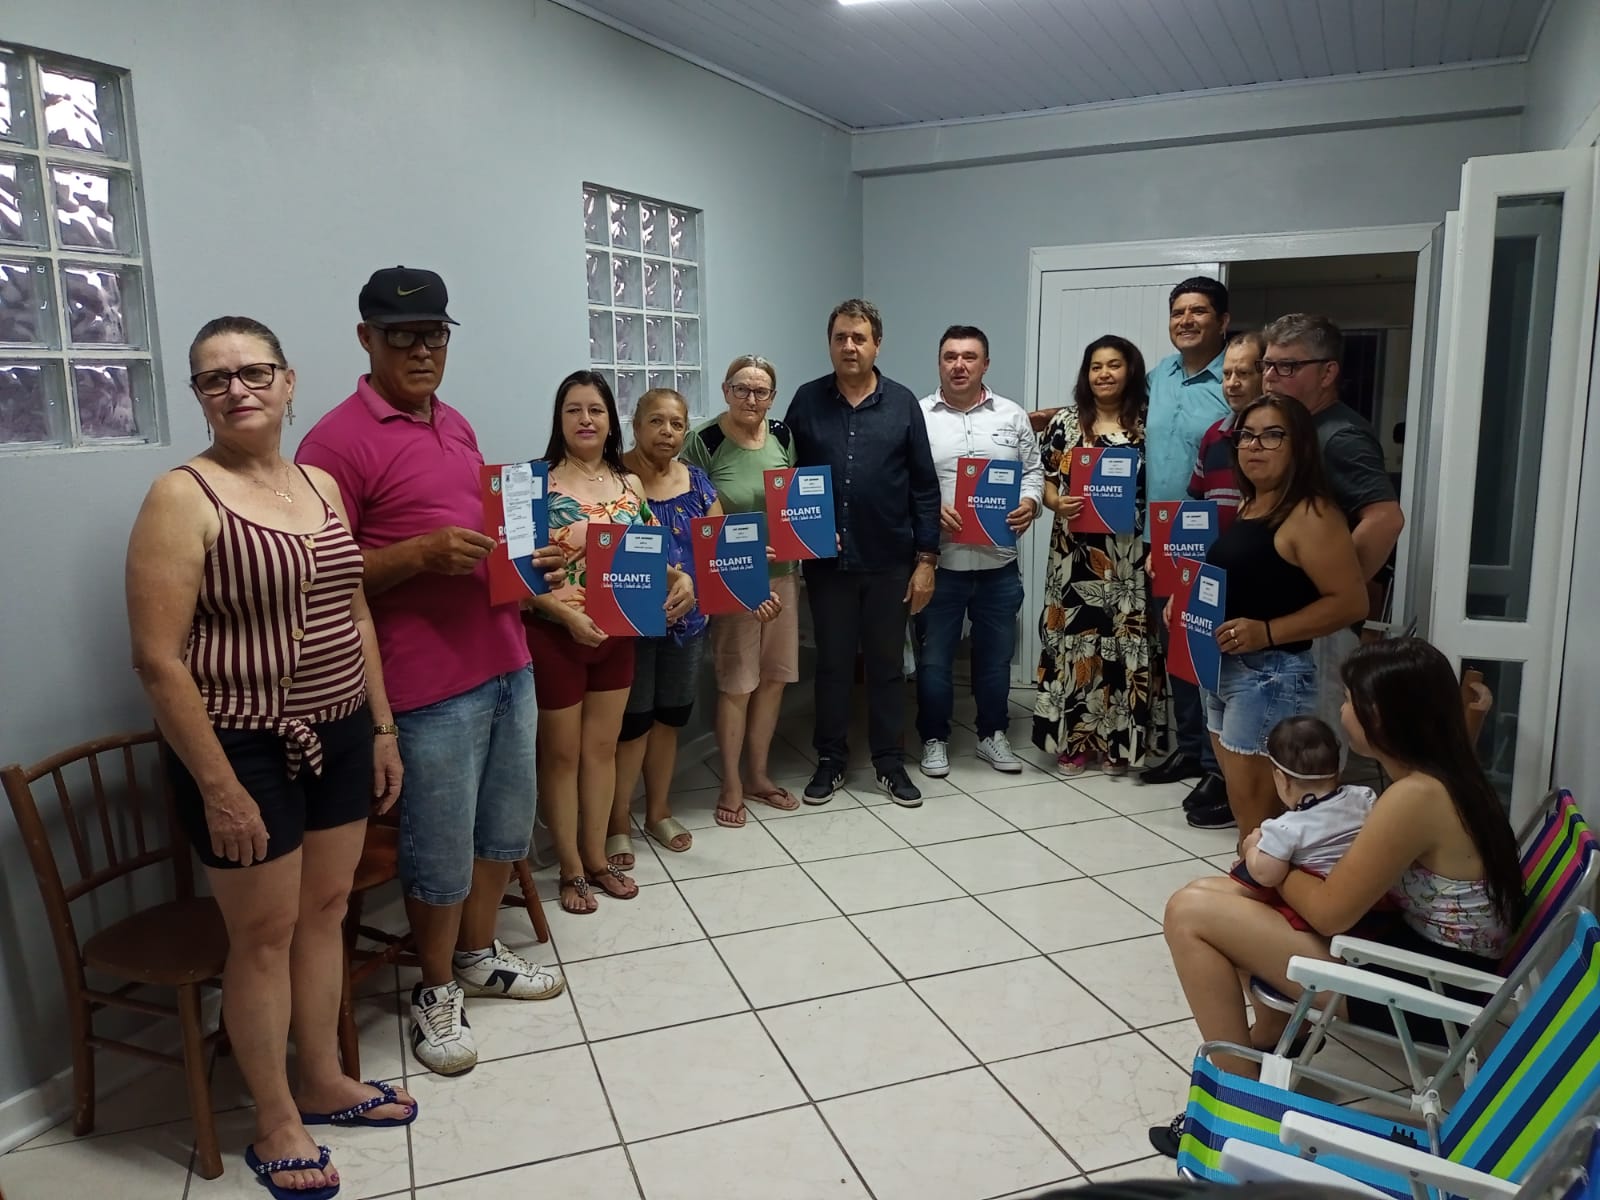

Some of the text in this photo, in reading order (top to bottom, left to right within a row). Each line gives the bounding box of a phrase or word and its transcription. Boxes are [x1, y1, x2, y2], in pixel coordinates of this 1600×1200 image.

[1083, 484, 1123, 493] ROLANTE
[967, 495, 1007, 505] ROLANTE
[780, 506, 821, 516] ROLANTE
[1163, 543, 1205, 552] ROLANTE
[709, 555, 753, 568] ROLANTE
[602, 572, 651, 583] ROLANTE
[1181, 610, 1213, 630] ROLANTE
